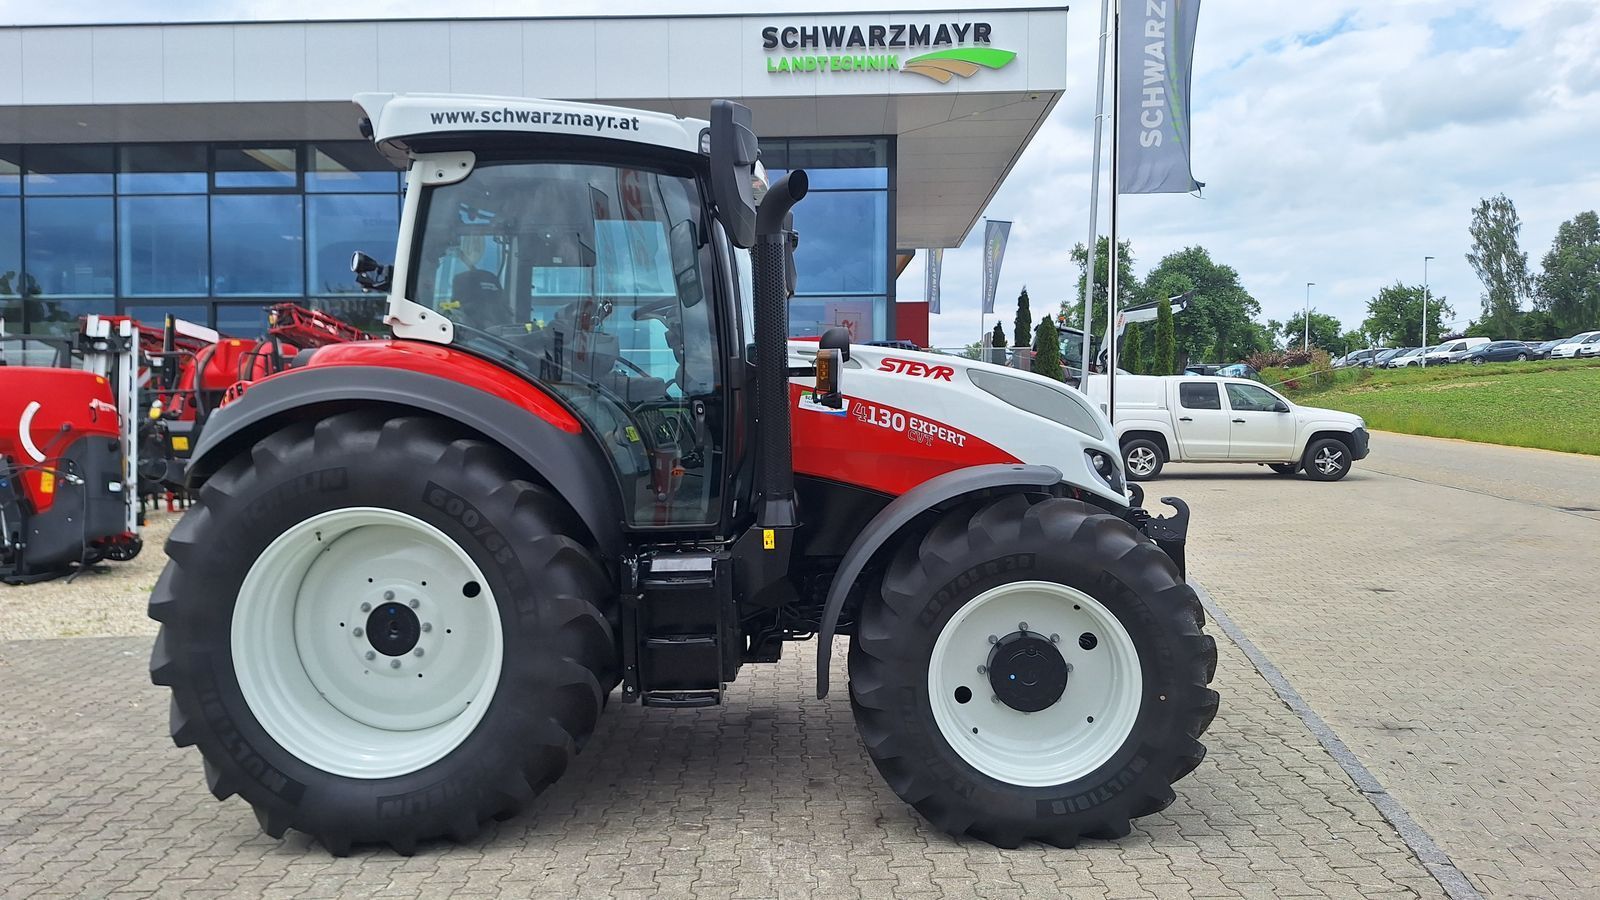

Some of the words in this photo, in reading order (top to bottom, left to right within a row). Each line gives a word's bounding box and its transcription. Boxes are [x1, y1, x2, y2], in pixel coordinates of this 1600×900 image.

[762, 23, 992, 49] SCHWARZMAYR
[767, 54, 899, 73] LANDTECHNIK
[430, 107, 640, 132] www.schwarzmayr.at
[877, 358, 954, 382] STEYR
[853, 403, 906, 432] 4130
[909, 417, 966, 447] EXPERT
[907, 430, 934, 447] CVT
[429, 488, 514, 564] 600/65
